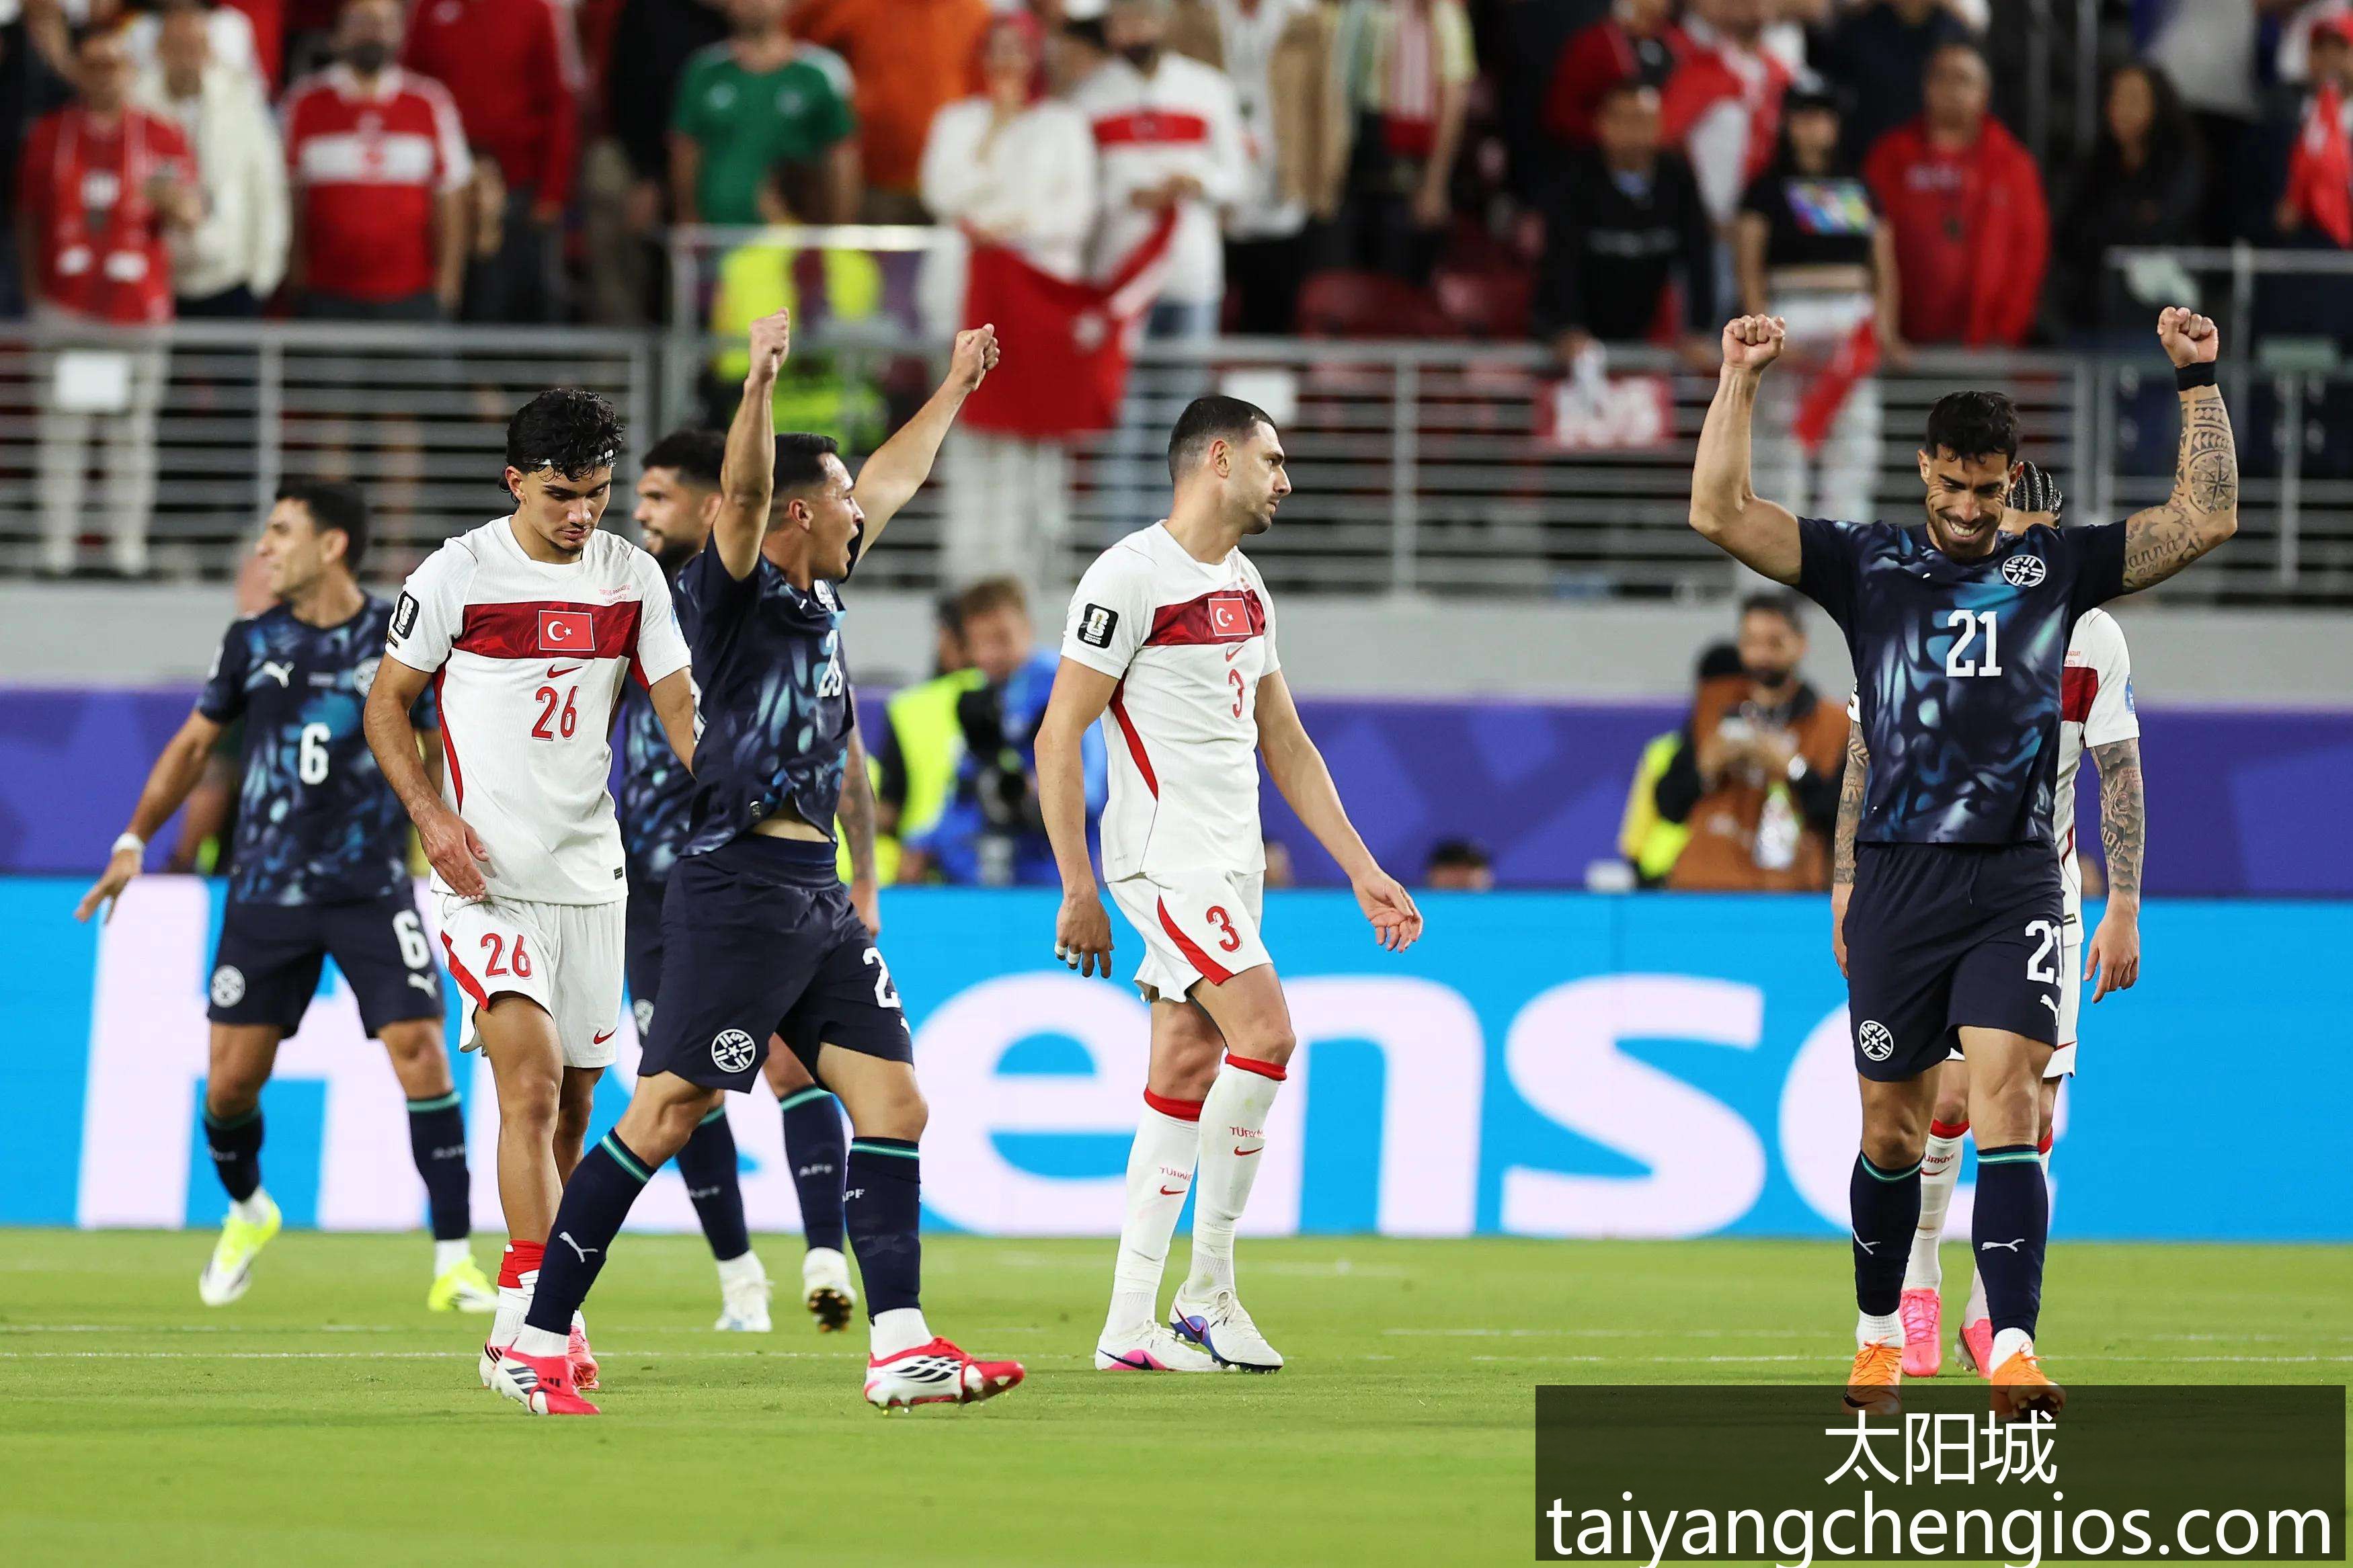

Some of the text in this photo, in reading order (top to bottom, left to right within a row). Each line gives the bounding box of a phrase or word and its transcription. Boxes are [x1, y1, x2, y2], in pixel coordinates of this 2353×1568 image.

[1946, 609, 2002, 677] 21
[531, 685, 579, 741] 26
[1228, 668, 1246, 718] 3
[299, 723, 331, 785] 6
[393, 910, 431, 969] 6
[479, 932, 534, 980] 26
[1205, 905, 1242, 952] 3
